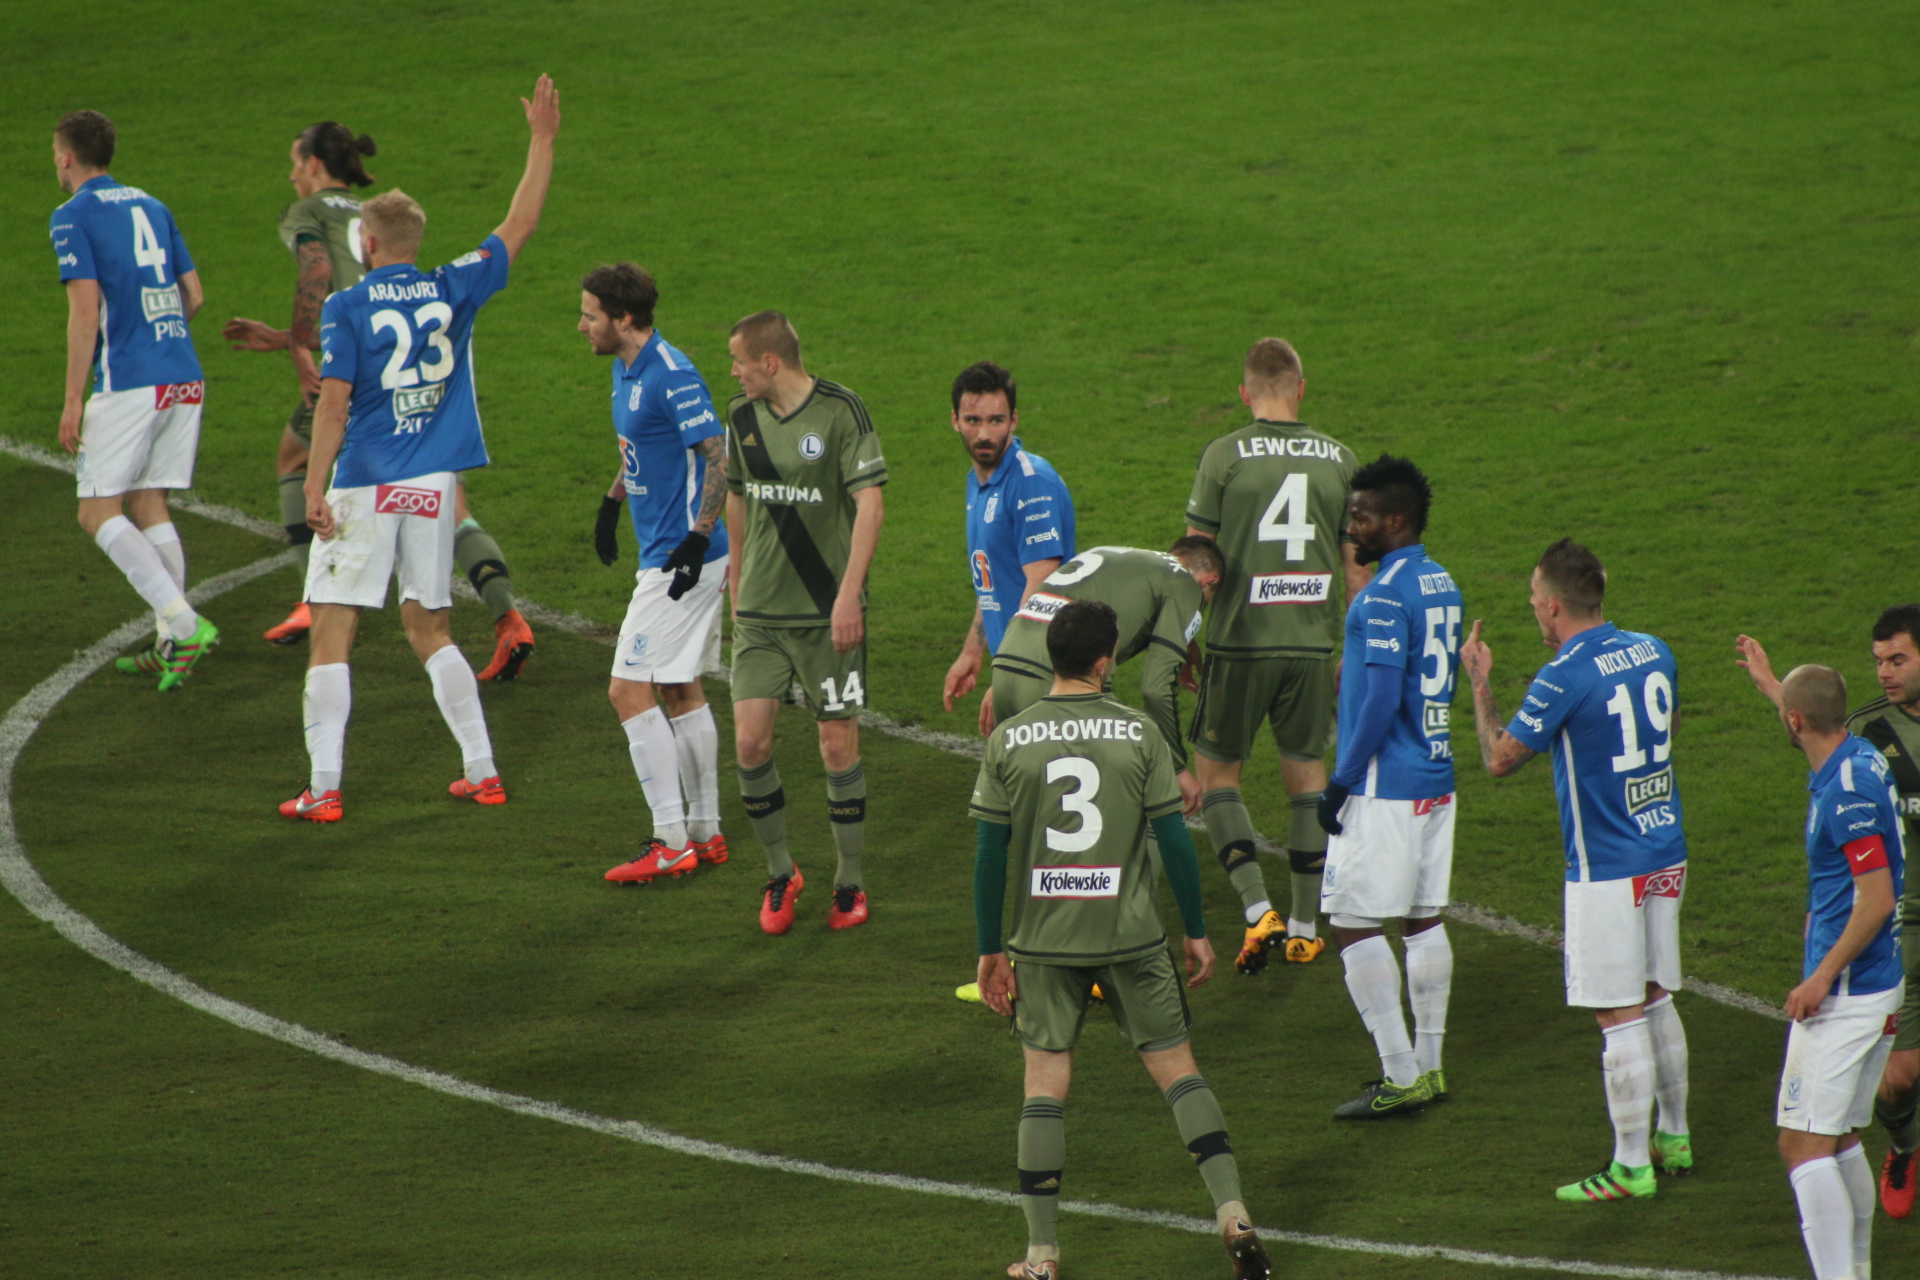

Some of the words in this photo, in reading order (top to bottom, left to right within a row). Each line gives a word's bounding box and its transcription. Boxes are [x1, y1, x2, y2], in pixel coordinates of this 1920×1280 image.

[130, 205, 167, 284] 4
[368, 281, 439, 302] ARAJUURI
[154, 320, 187, 341] PILS
[370, 301, 455, 390] 23
[1237, 436, 1343, 464] LEWCZUK
[378, 488, 439, 514] Fogo
[745, 482, 823, 503] FORTUNA
[1258, 473, 1315, 561] 4
[1258, 578, 1323, 600] Królewskie
[1420, 605, 1462, 697] 55
[1593, 649, 1633, 676] NICKI
[1625, 640, 1661, 667] BILLE
[821, 670, 865, 712] 14
[1005, 718, 1143, 750] JODŁOWIEC
[1606, 671, 1674, 773] 19
[1046, 756, 1104, 853] 3
[1630, 775, 1669, 804] LECH
[1635, 805, 1676, 836] PILS
[1040, 871, 1111, 894] Królewskie
